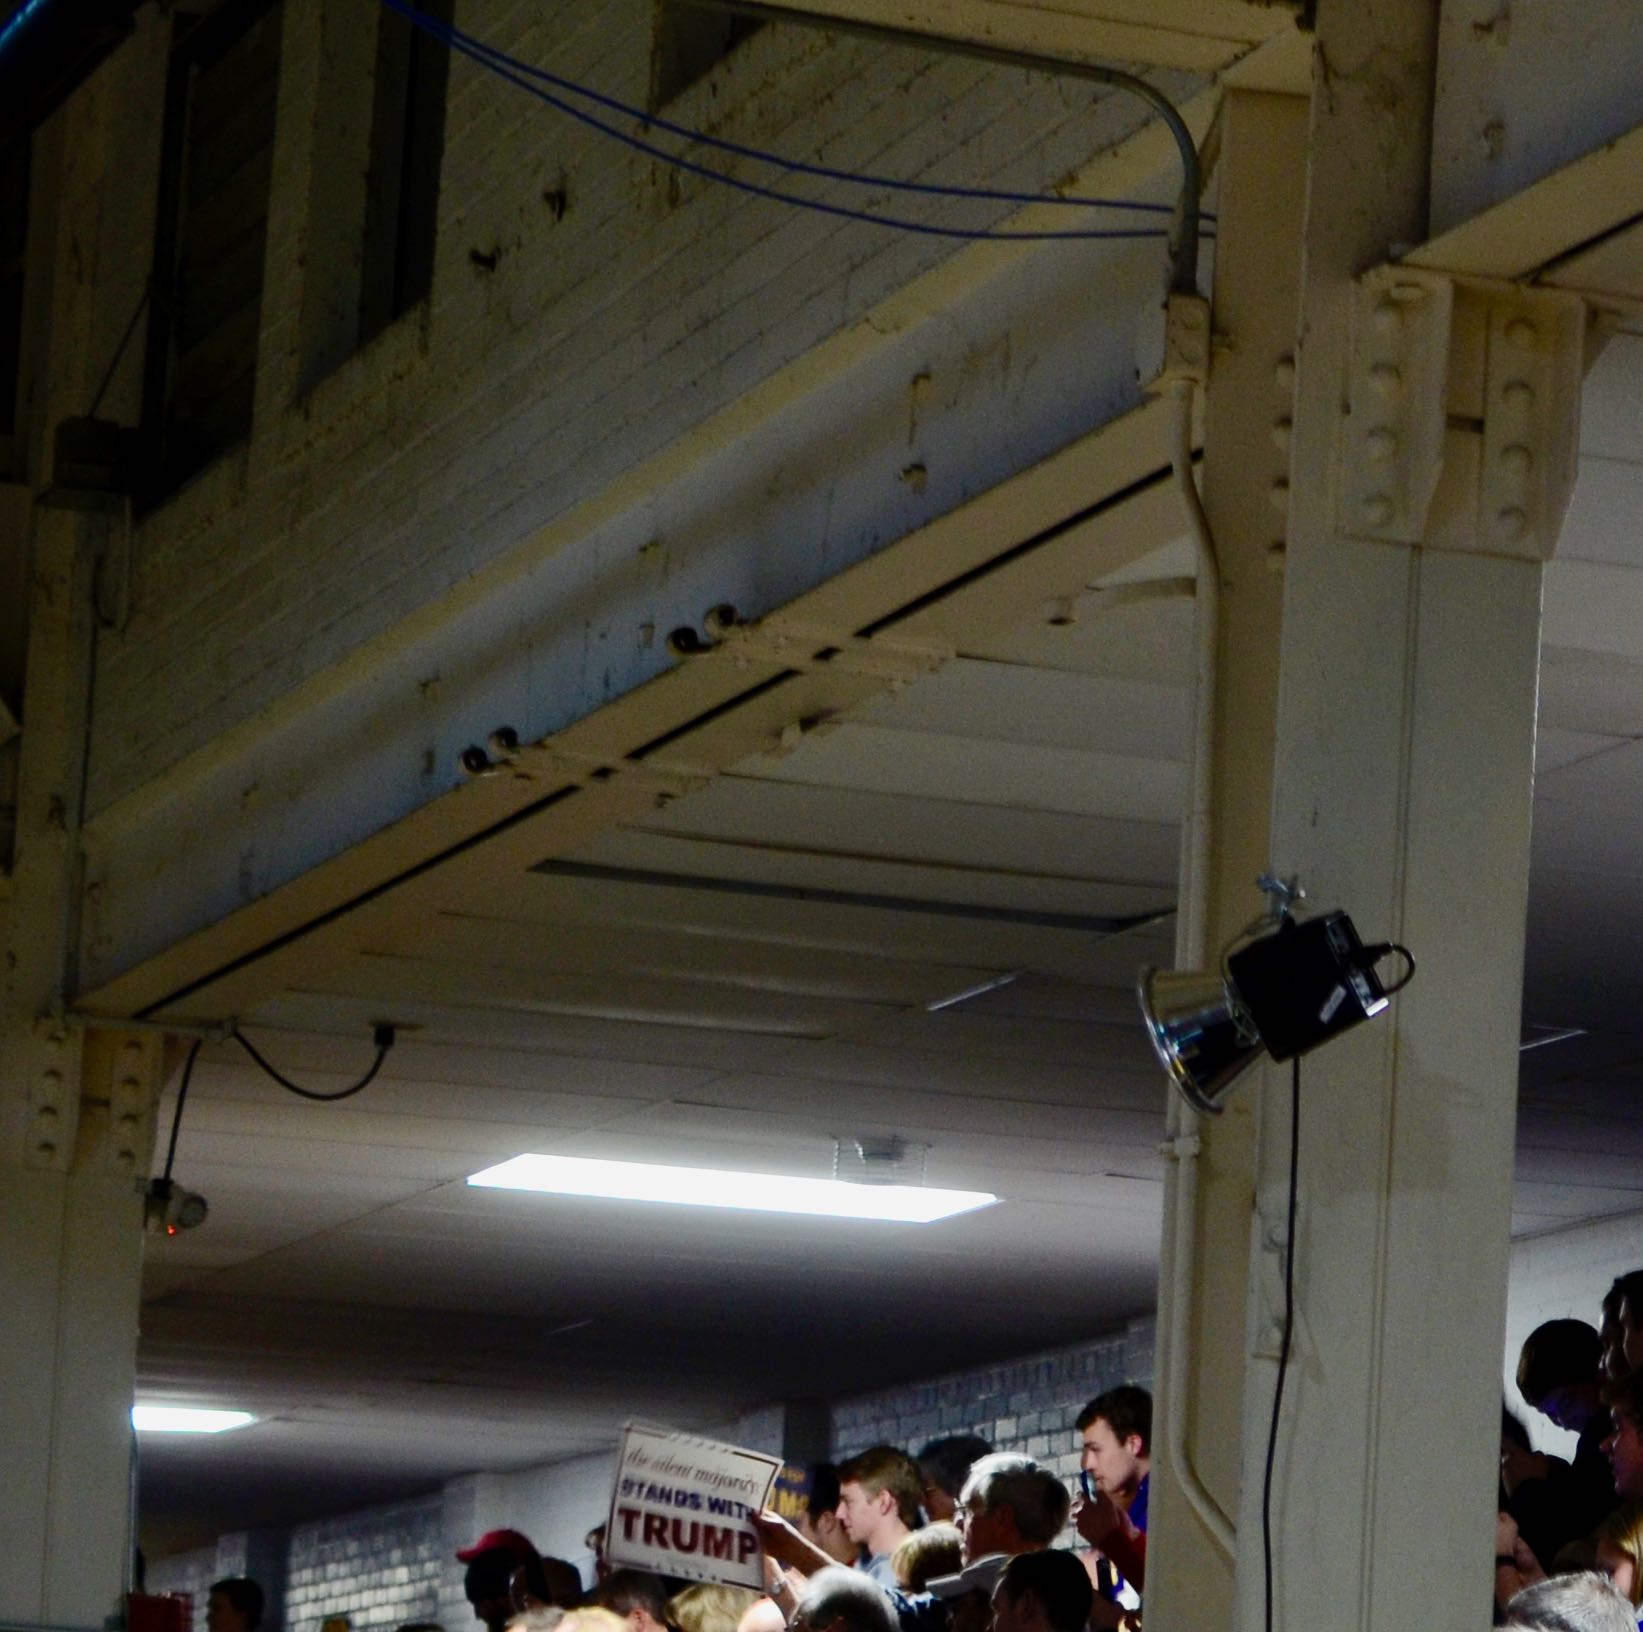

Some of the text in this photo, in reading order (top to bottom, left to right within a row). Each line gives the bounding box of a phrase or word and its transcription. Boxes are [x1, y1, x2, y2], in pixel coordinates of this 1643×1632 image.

[621, 1478, 701, 1511] STANDS
[652, 1454, 693, 1480] silent
[694, 1466, 762, 1497] majority
[617, 1507, 758, 1564] TRUMP
